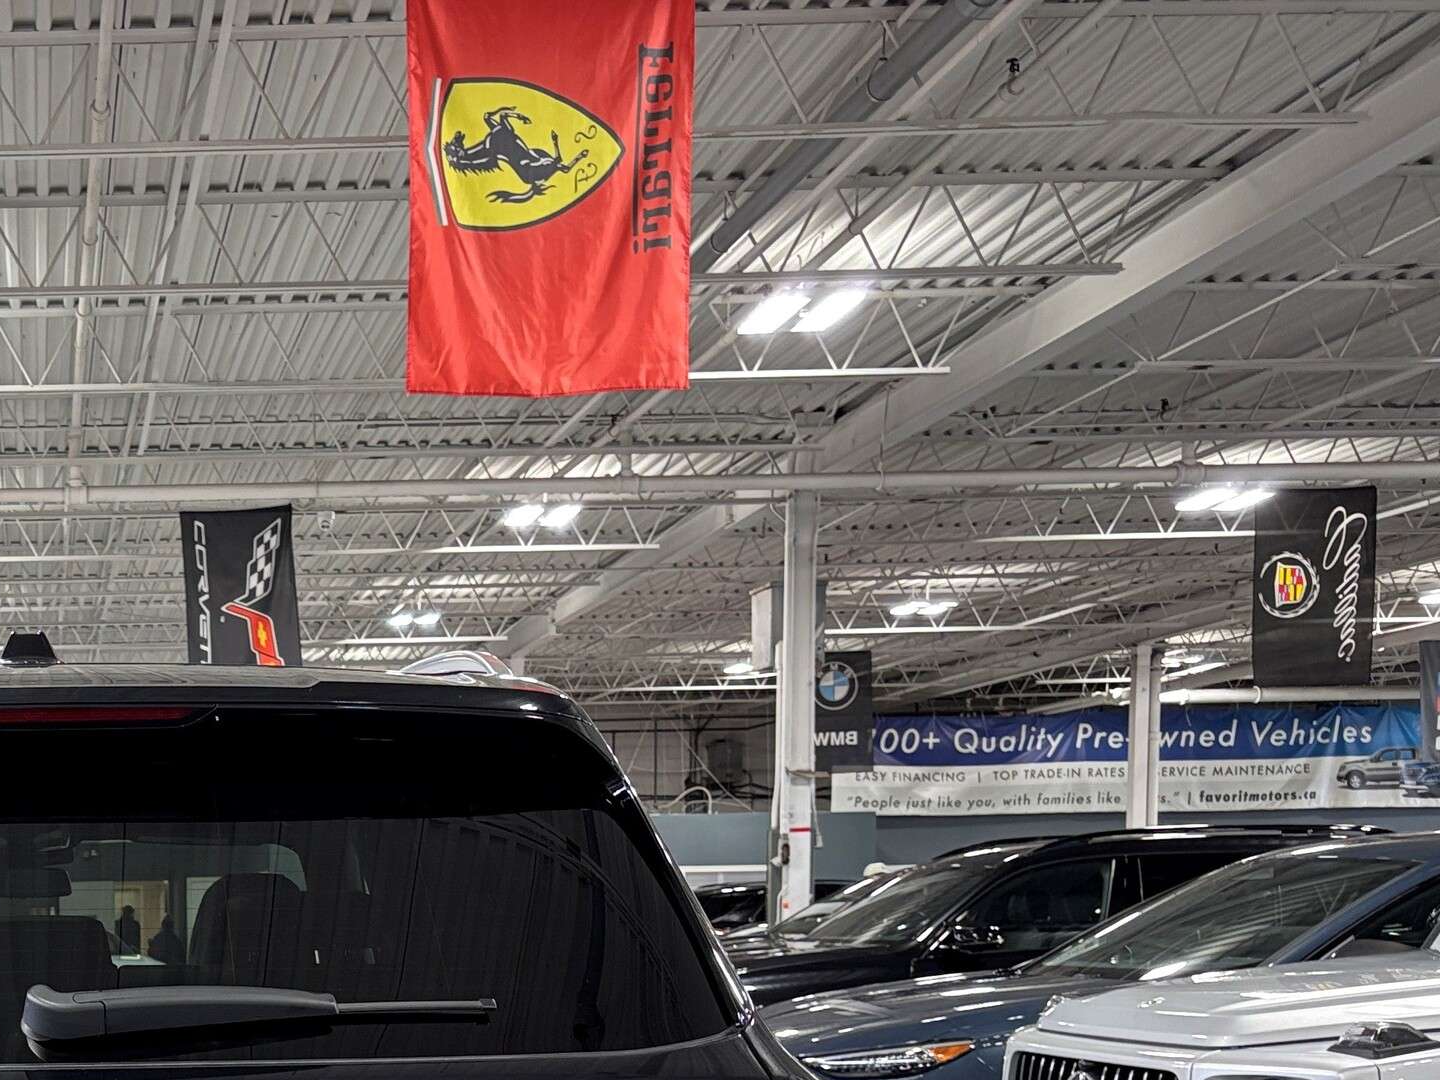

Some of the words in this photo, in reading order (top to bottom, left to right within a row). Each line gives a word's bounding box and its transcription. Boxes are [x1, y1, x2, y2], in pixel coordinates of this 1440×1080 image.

[953, 724, 1064, 758] Quality
[1251, 715, 1373, 746] Vehicles
[855, 771, 886, 782] EASY
[892, 771, 967, 783] FINANCING
[993, 770, 1018, 781] TOP
[1024, 768, 1081, 780] TRADE-IN
[1088, 768, 1125, 778] RATES
[1158, 766, 1206, 778] ERVICE
[1212, 762, 1311, 776] MAINTENANCE
[906, 796, 932, 811] just
[937, 796, 962, 808] like
[1002, 794, 1031, 806] with
[1036, 793, 1092, 807] families
[1097, 791, 1121, 804] like
[1199, 789, 1317, 805] favoritmotors.ca
